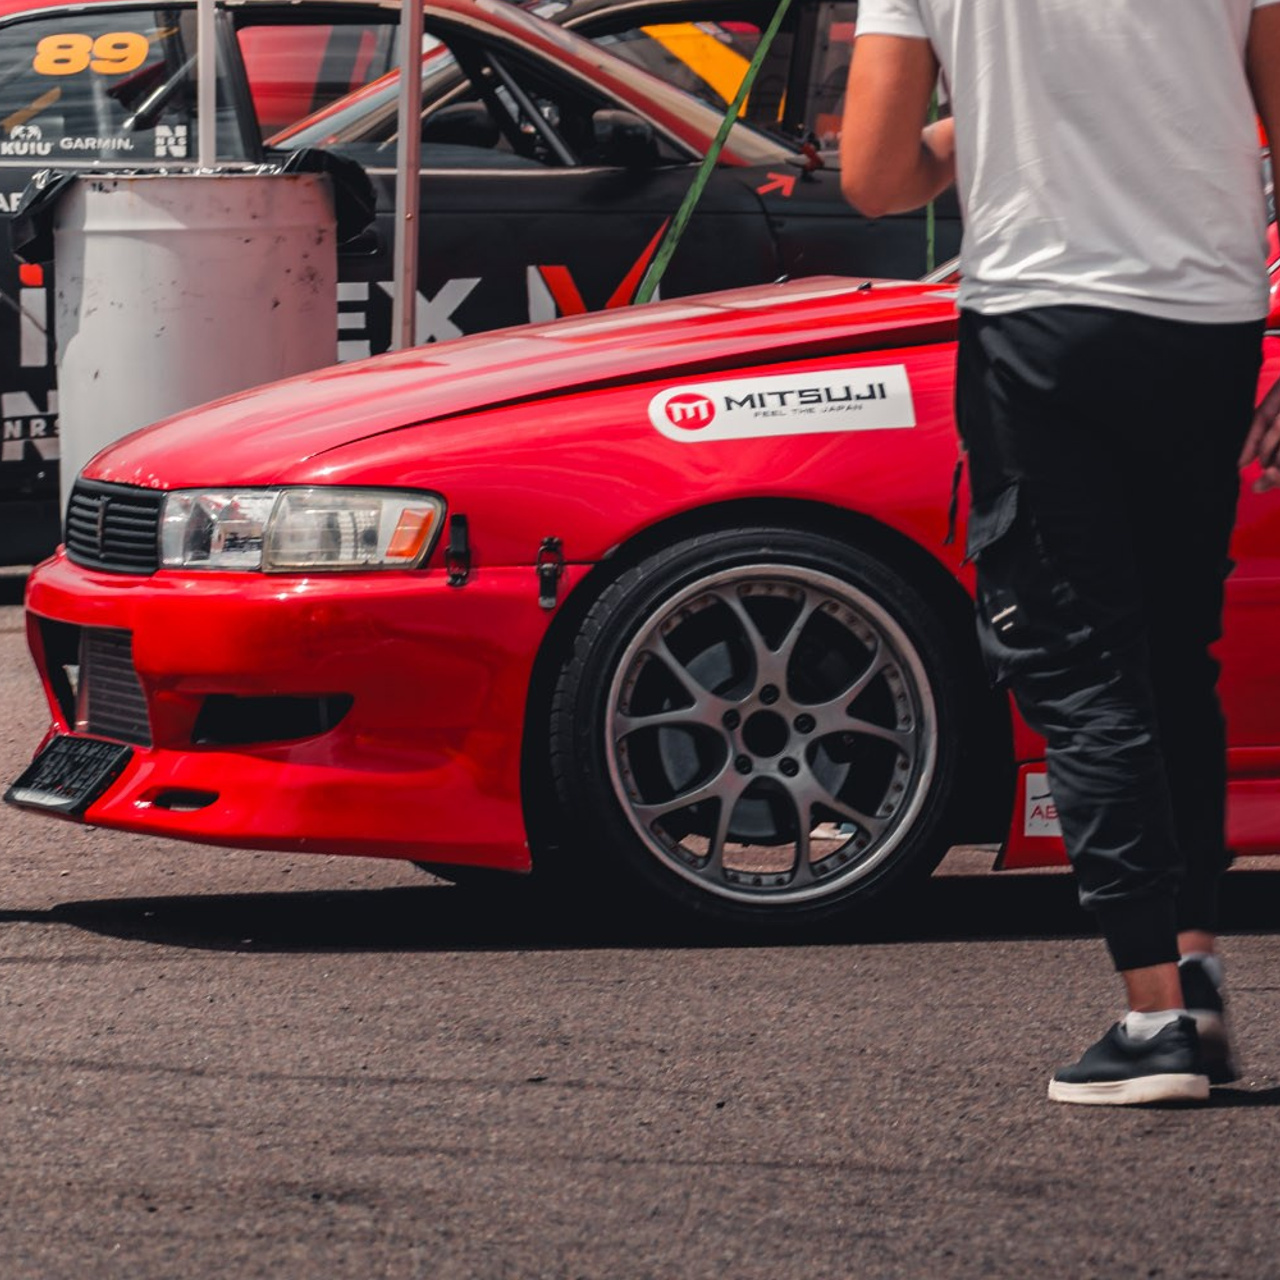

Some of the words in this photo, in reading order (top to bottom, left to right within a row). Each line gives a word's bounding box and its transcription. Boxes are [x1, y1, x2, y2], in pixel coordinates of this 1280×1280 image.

[33, 32, 150, 75] 89
[0, 141, 52, 156] KUIU
[724, 382, 887, 411] MITSUJI
[754, 409, 786, 418] FEEL
[791, 406, 817, 415] THE
[821, 403, 863, 413] JAPAN
